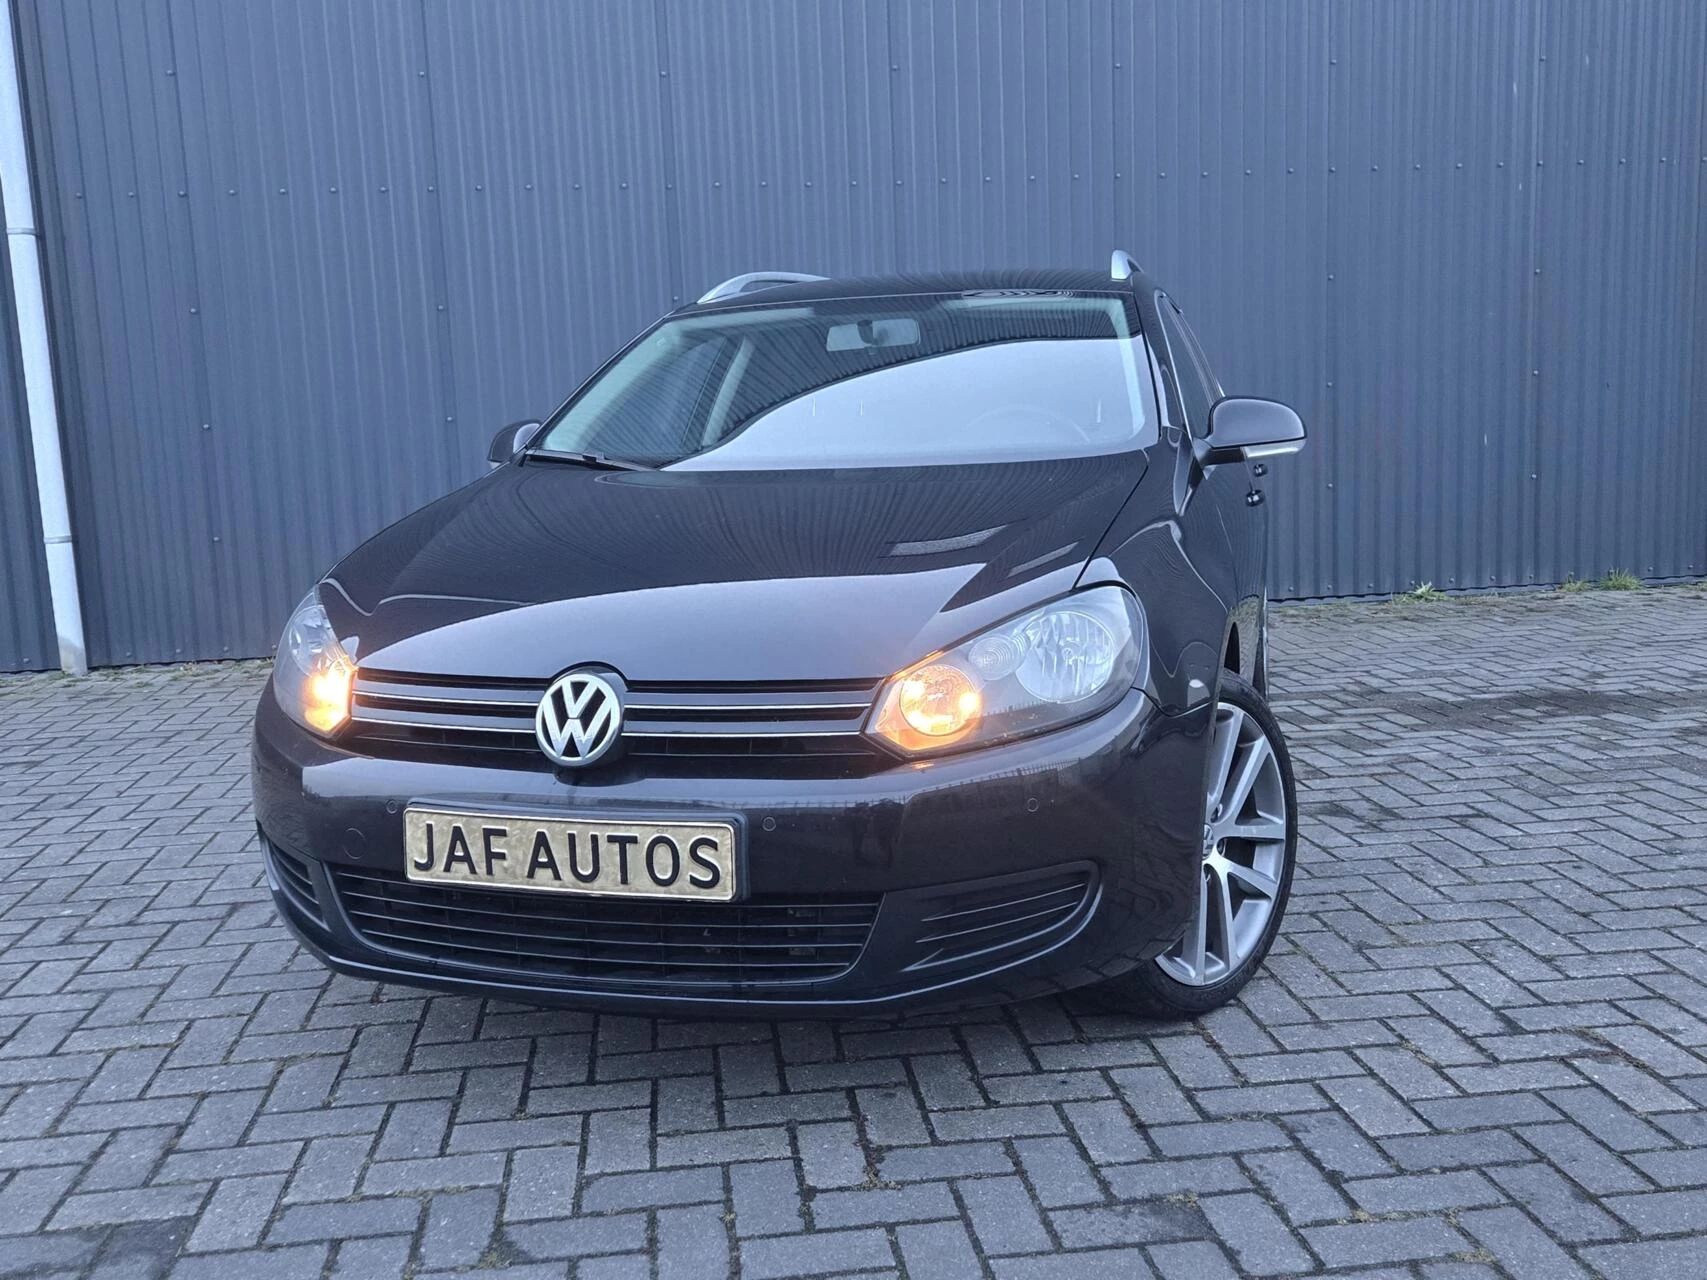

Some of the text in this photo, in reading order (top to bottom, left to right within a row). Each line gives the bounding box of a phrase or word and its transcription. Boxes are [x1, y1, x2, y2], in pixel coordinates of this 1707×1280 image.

[537, 674, 617, 764] VW
[413, 822, 722, 889] JAF AUTOS
